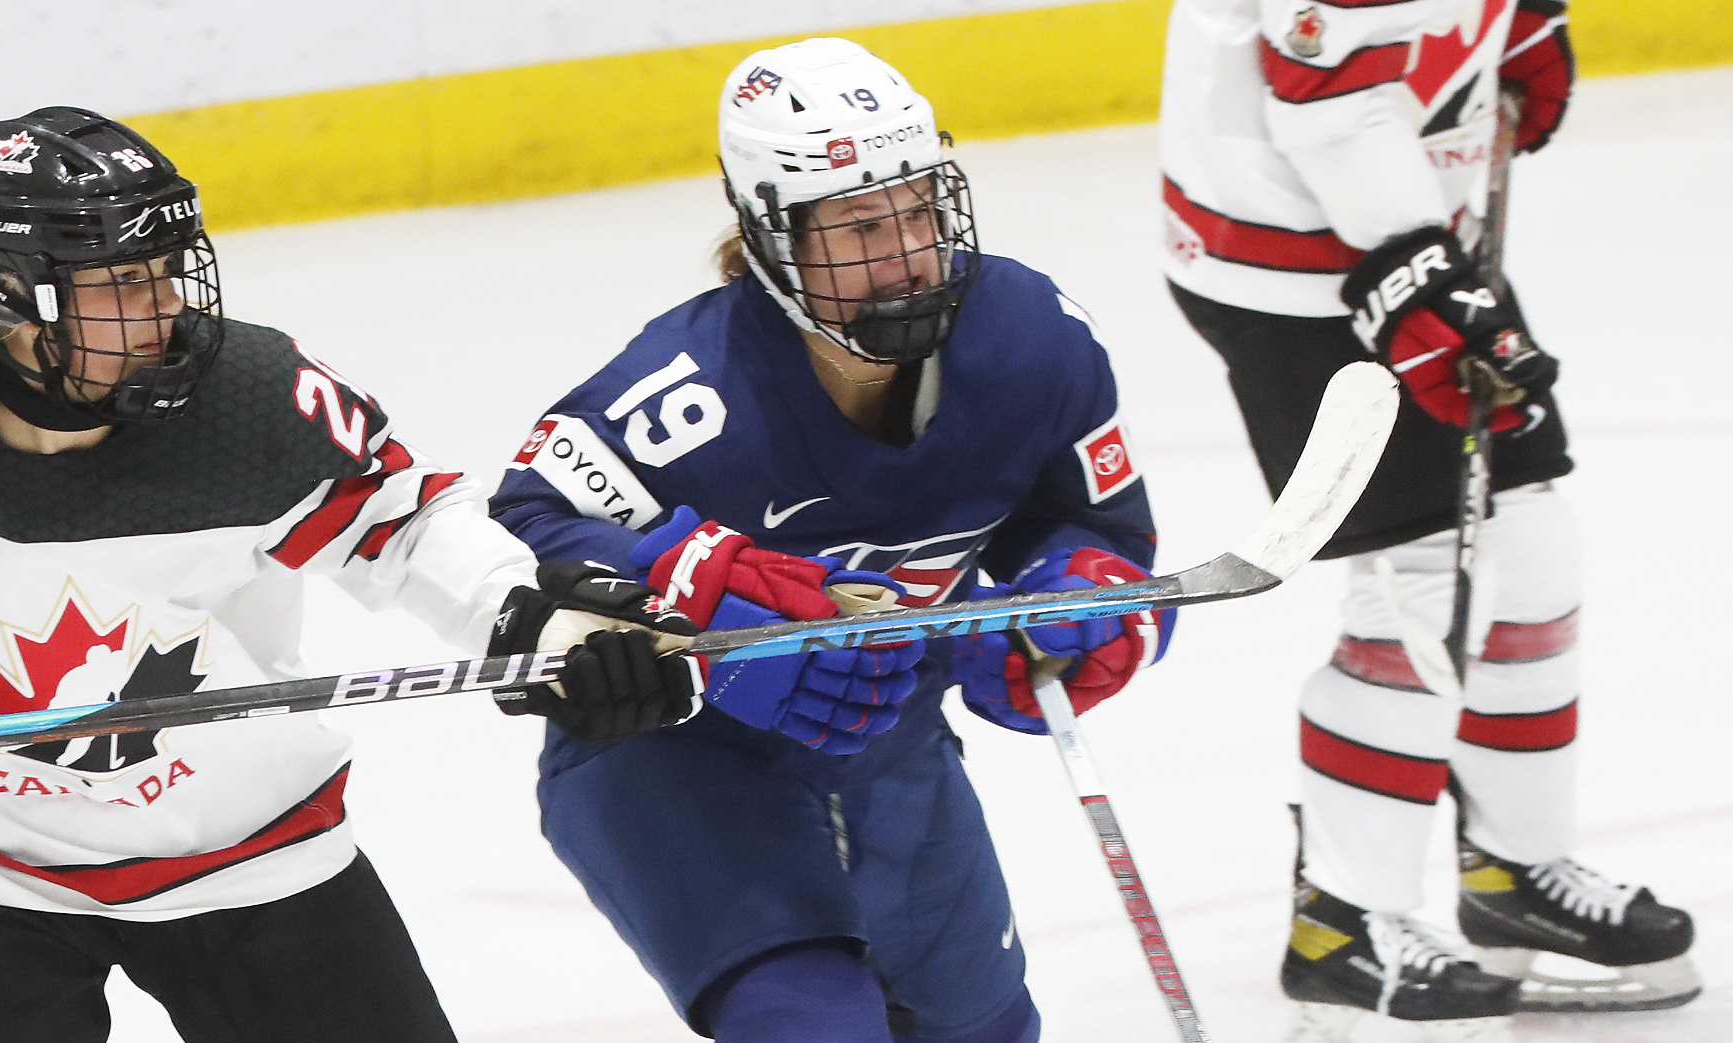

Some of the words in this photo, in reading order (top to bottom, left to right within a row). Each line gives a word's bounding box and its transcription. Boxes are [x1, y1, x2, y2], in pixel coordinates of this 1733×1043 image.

[839, 88, 881, 112] 19
[862, 124, 925, 152] TOYOTA
[160, 198, 202, 223] TELU
[604, 352, 728, 468] 19
[551, 434, 635, 527] OYOTA
[329, 648, 568, 708] BAUE
